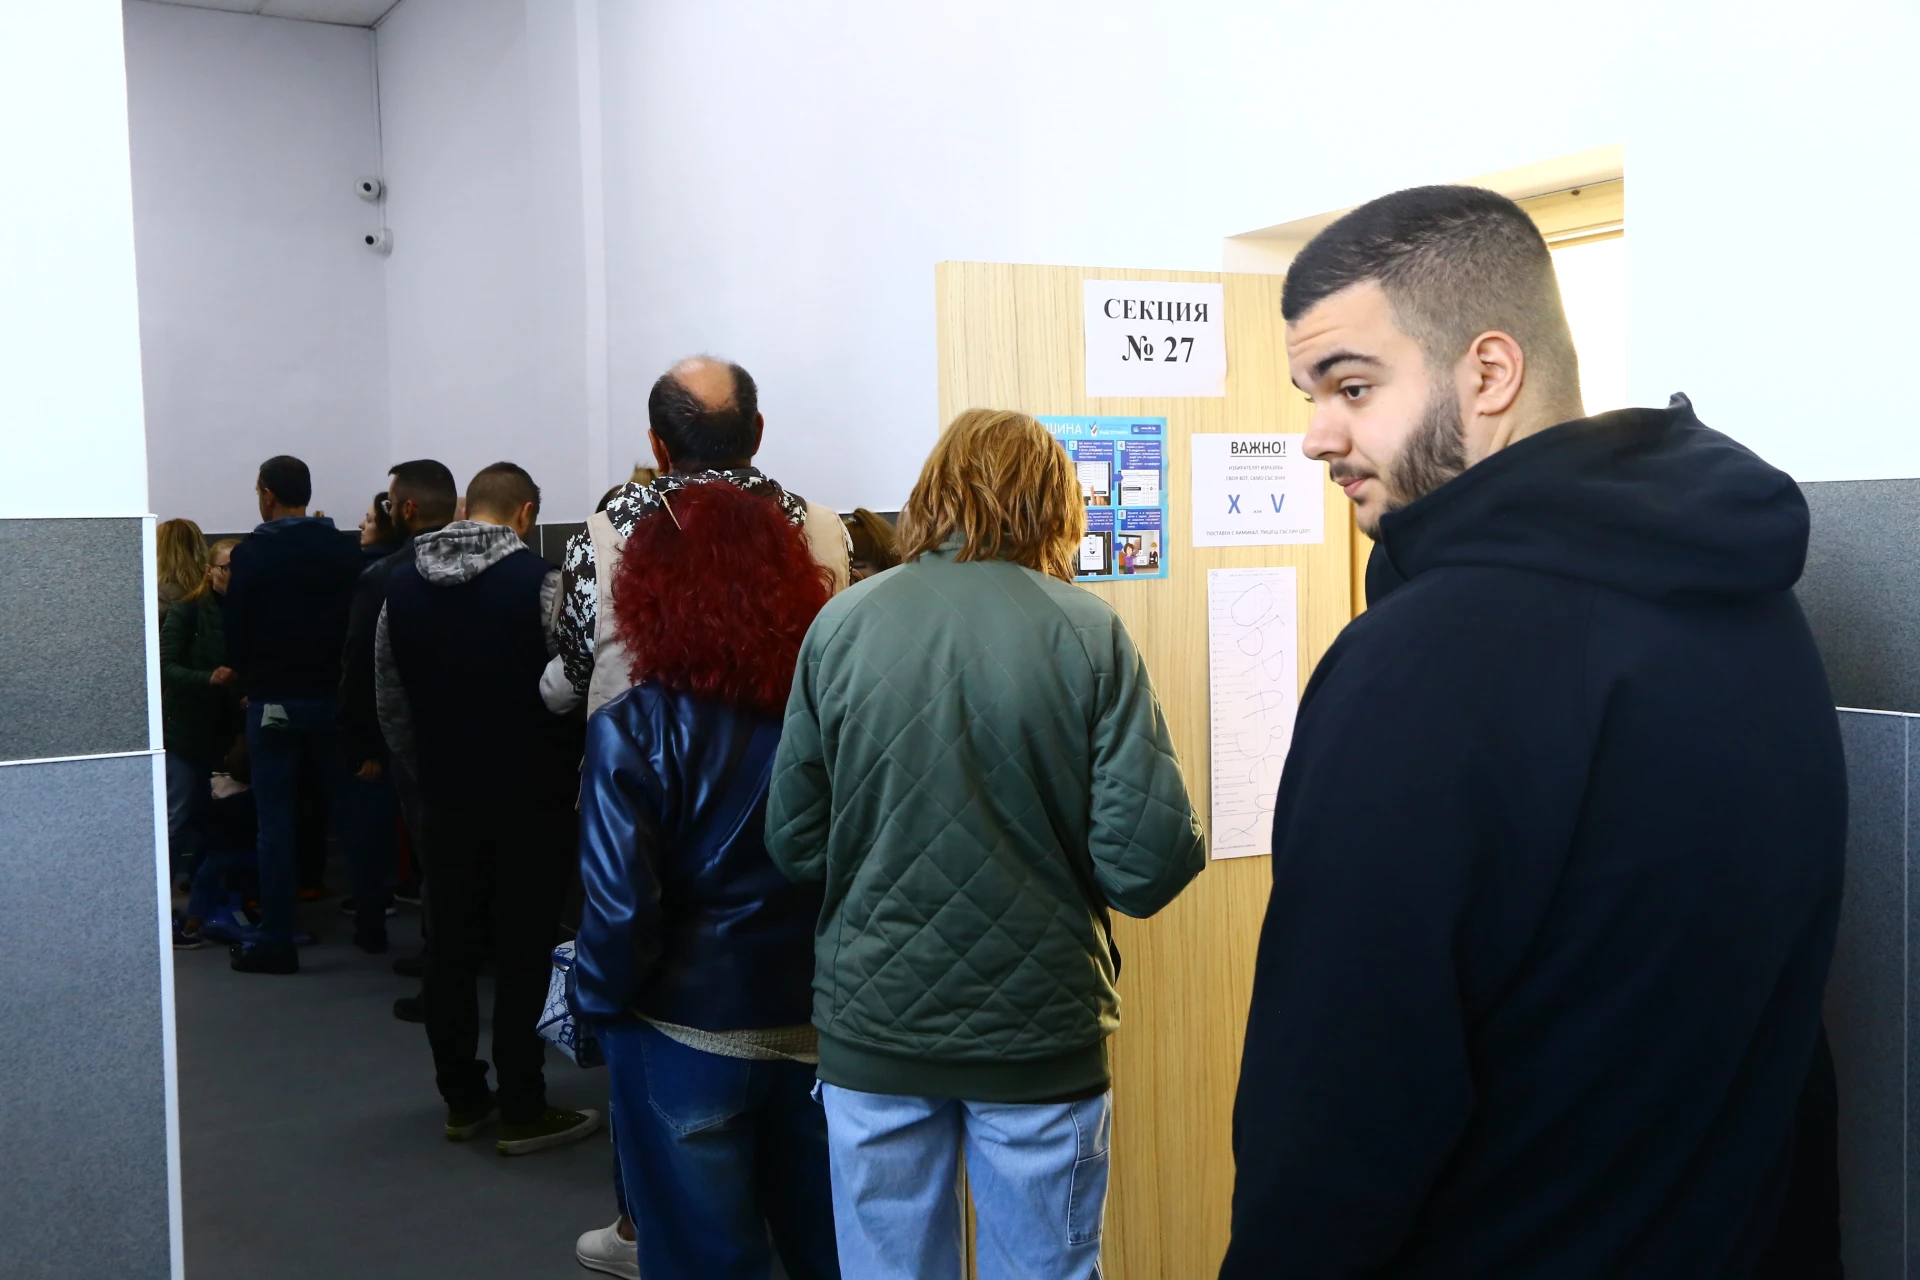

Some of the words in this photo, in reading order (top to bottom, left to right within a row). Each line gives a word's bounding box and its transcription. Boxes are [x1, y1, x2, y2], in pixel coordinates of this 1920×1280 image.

[1103, 298, 1209, 326] СЕКЦИЯ
[1121, 334, 1154, 361] №
[1163, 336, 1195, 363] 27
[1230, 440, 1287, 454] ВАЖНО!
[1270, 493, 1285, 514] V
